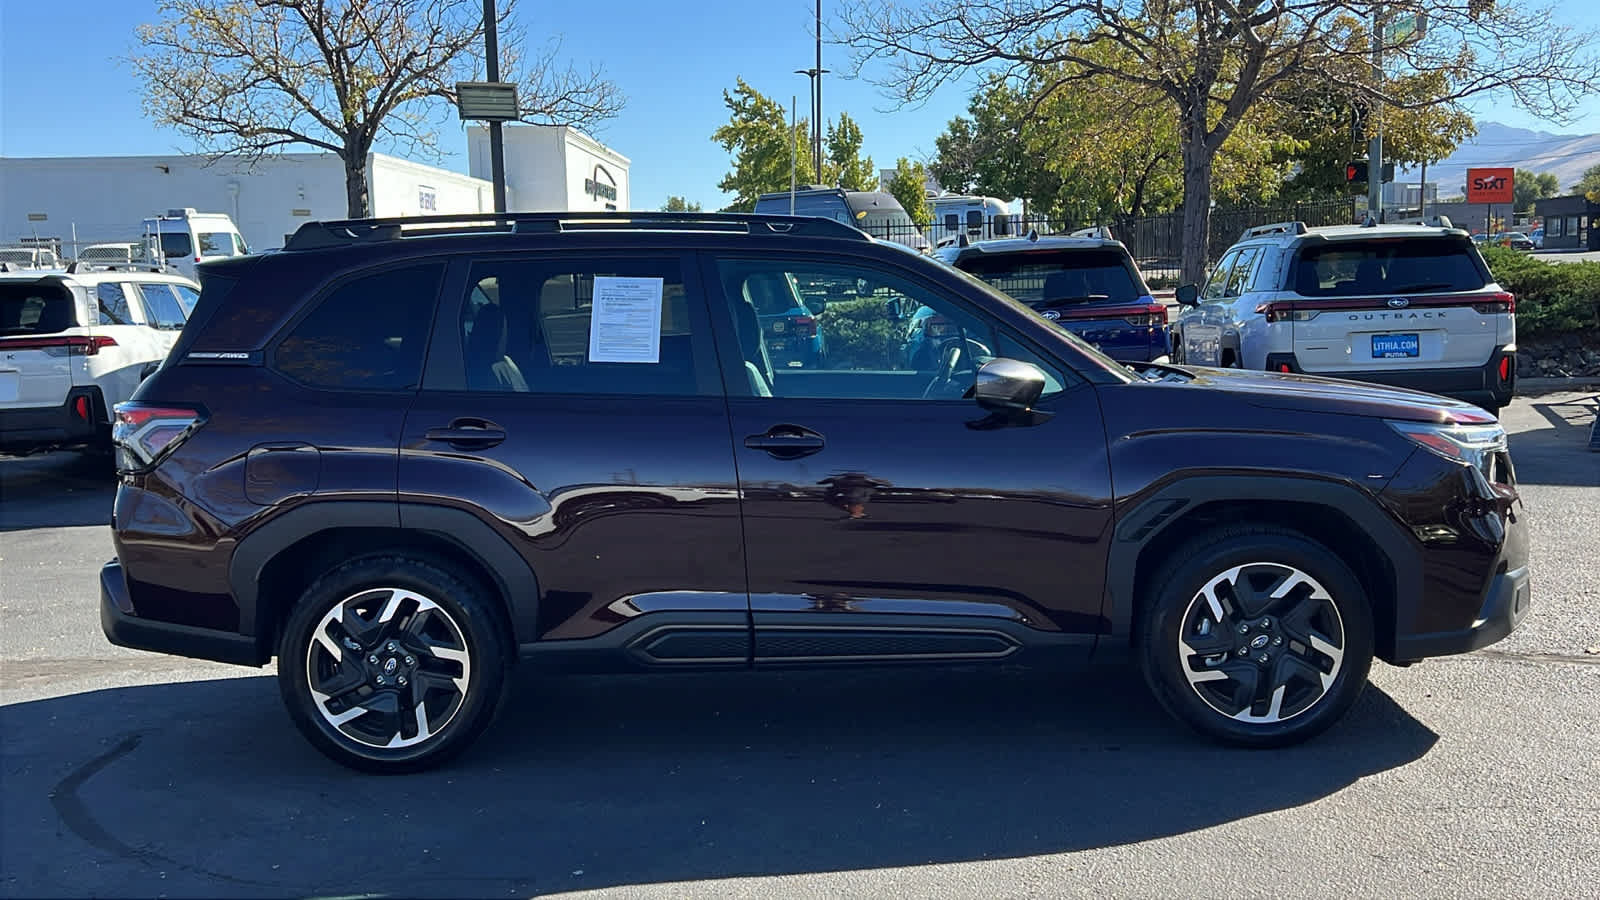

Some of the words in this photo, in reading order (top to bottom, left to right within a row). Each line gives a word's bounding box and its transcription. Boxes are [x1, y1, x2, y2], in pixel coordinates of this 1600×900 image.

[1473, 176, 1507, 190] SIXT
[1348, 311, 1446, 321] OUTBACK
[1373, 340, 1418, 351] LITHIA.COM
